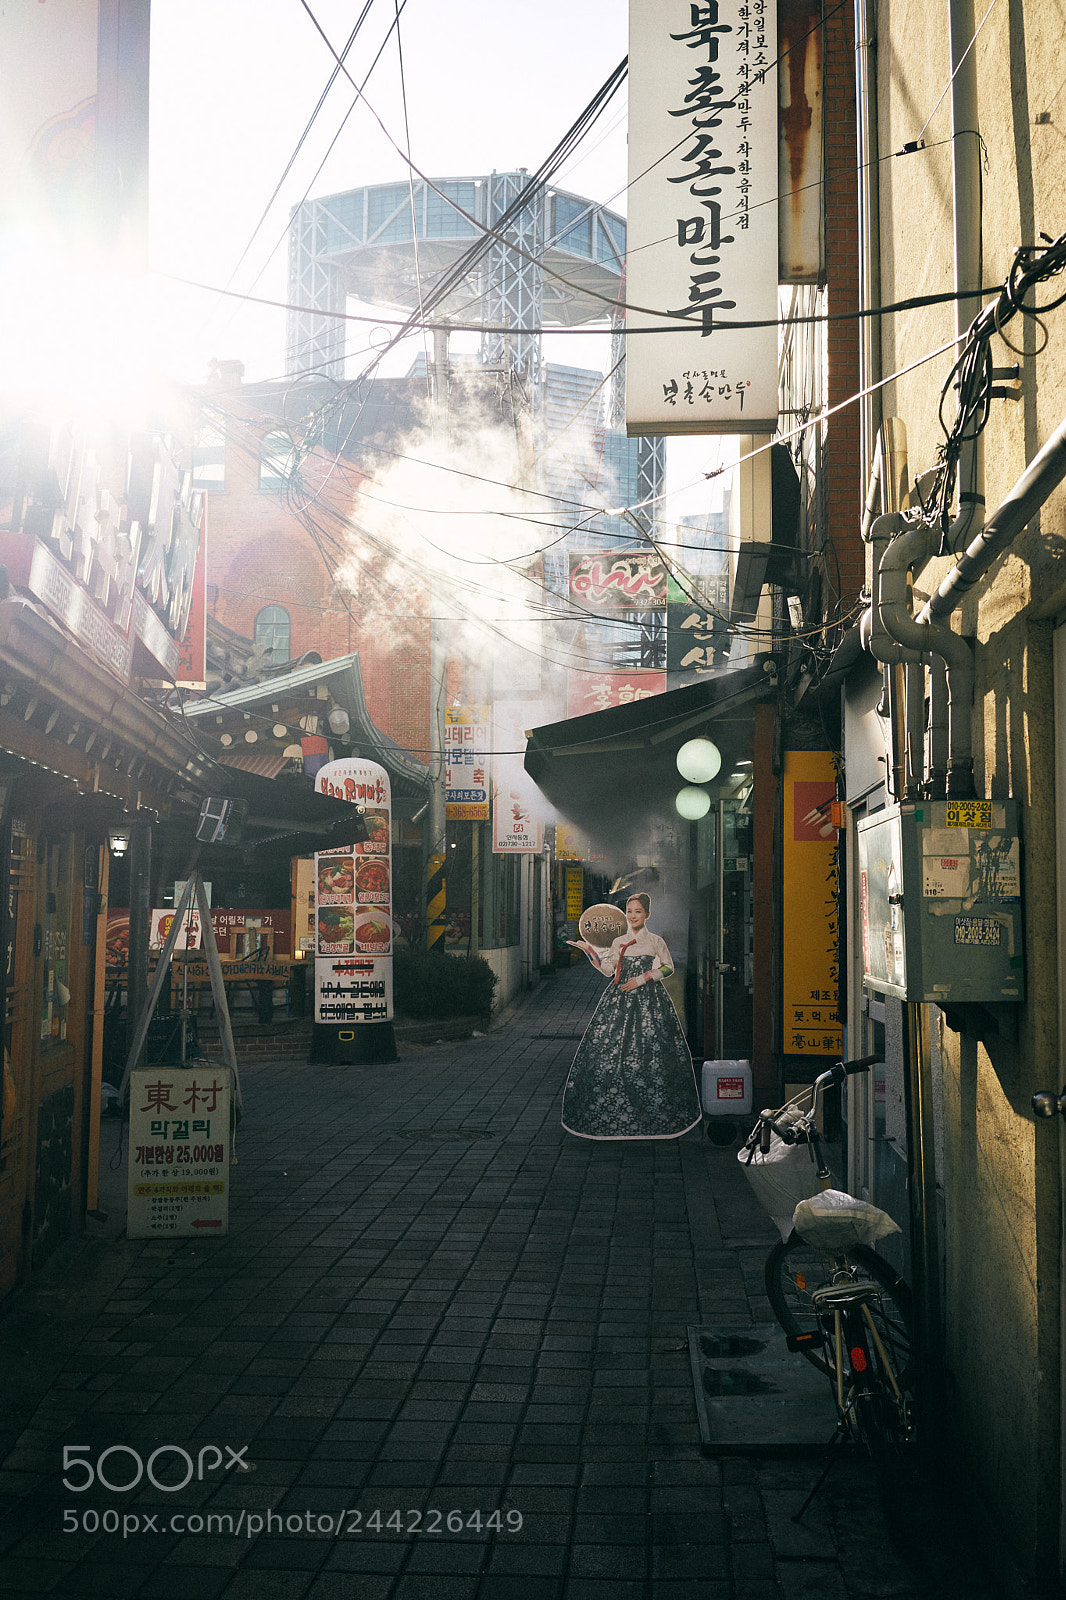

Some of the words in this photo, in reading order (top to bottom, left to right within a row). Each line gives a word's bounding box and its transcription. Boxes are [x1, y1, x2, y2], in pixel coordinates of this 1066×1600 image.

[667, 0, 737, 338] 북촌손만두
[662, 378, 746, 412] 북촌손만두
[947, 801, 992, 811] 010-2005-2424
[219, 915, 245, 925] 어릴적
[265, 963, 288, 978] 서비스
[139, 1079, 223, 1115] 東村
[151, 1120, 211, 1141] 막걸리
[135, 1145, 174, 1165] 기본한상
[176, 1144, 224, 1164] 25,000원
